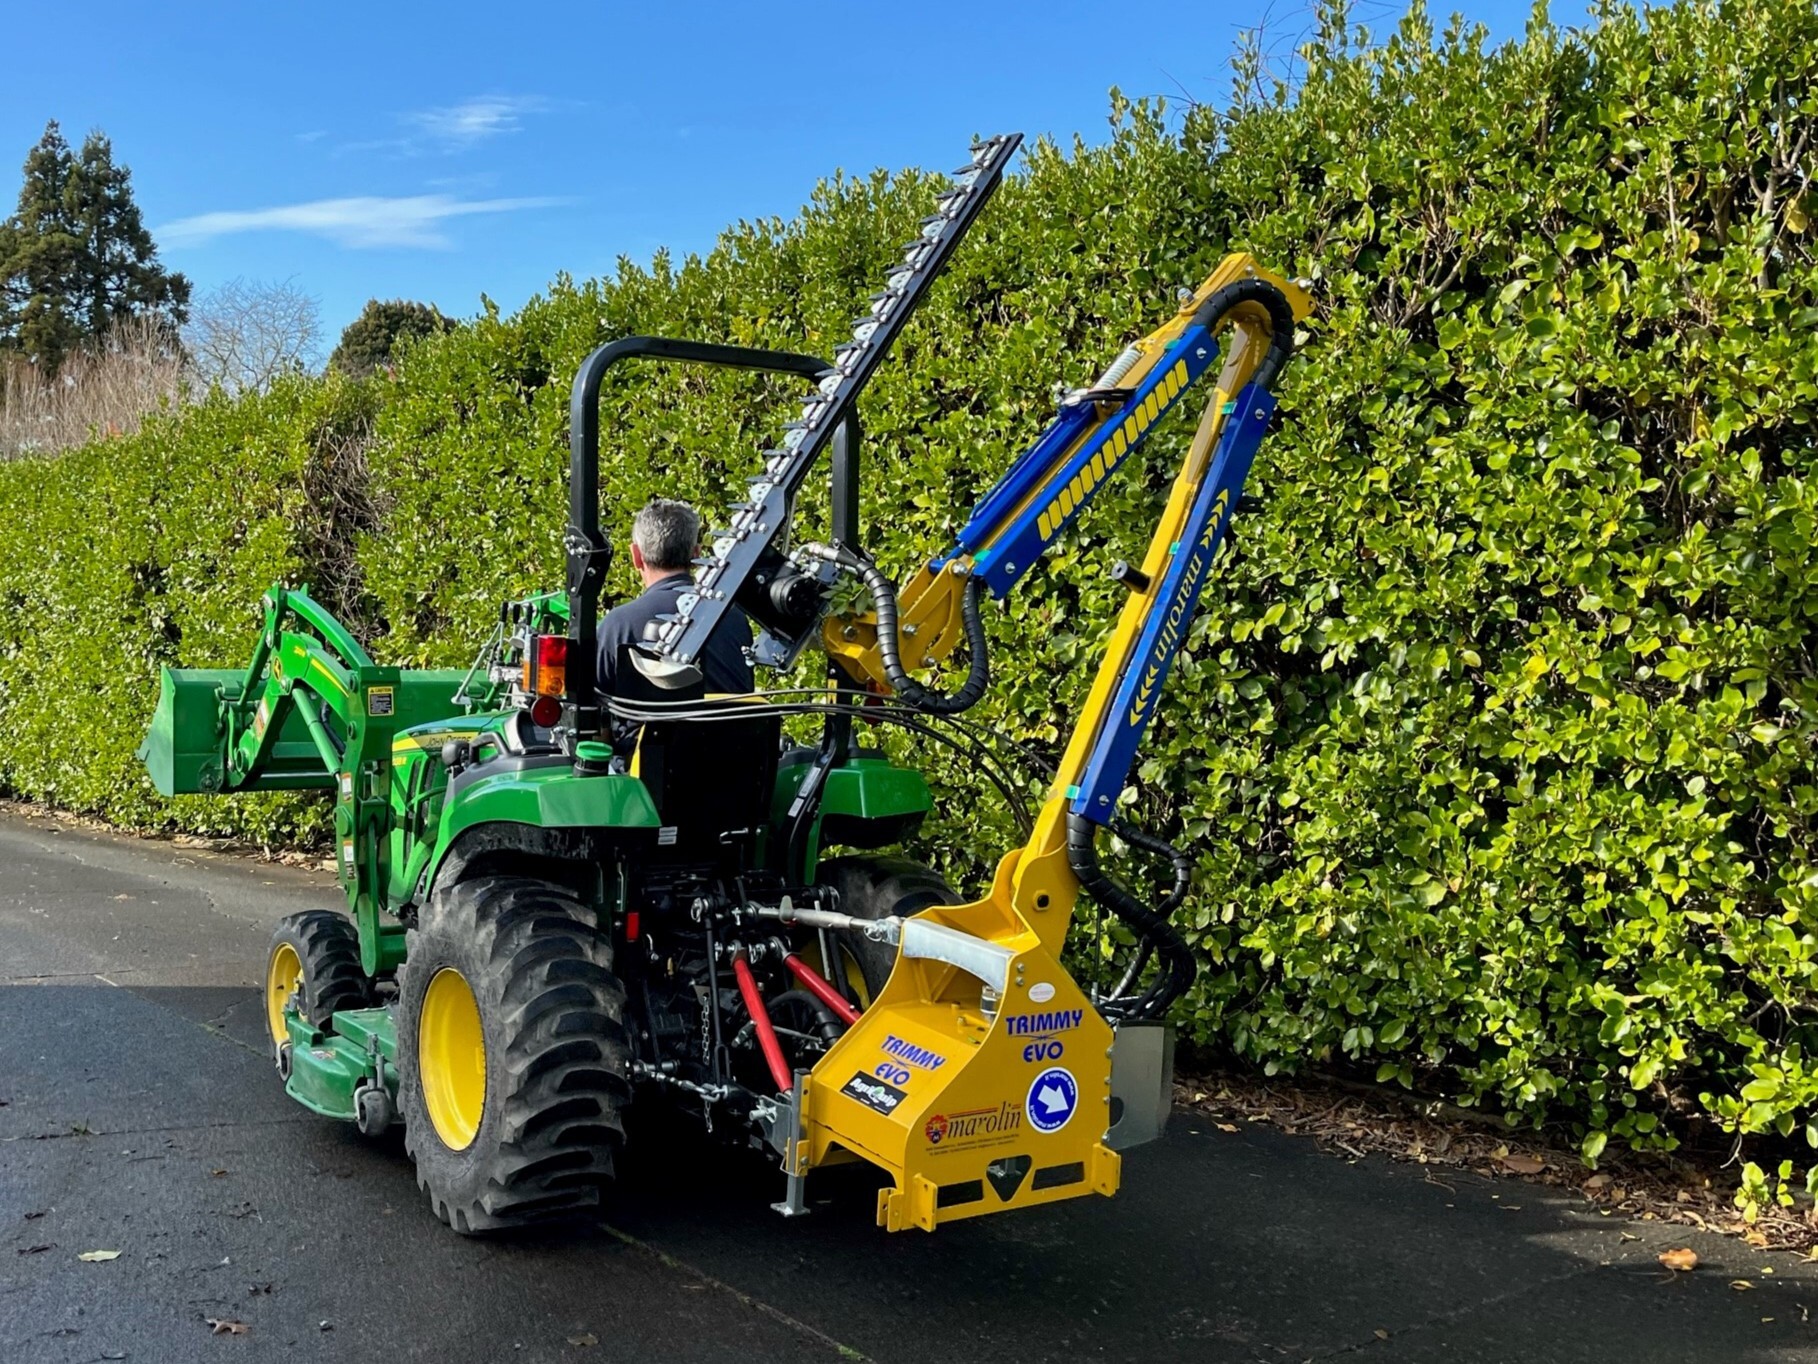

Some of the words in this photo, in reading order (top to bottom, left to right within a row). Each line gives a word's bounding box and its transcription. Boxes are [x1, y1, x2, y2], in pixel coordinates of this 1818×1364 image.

[1154, 551, 1203, 662] marolin
[1005, 1008, 1083, 1035] TRIMMY
[881, 1034, 947, 1071] TRIMMY
[1023, 1041, 1064, 1063] EVO
[875, 1063, 910, 1086] EVO
[947, 1101, 1022, 1139] marolin
